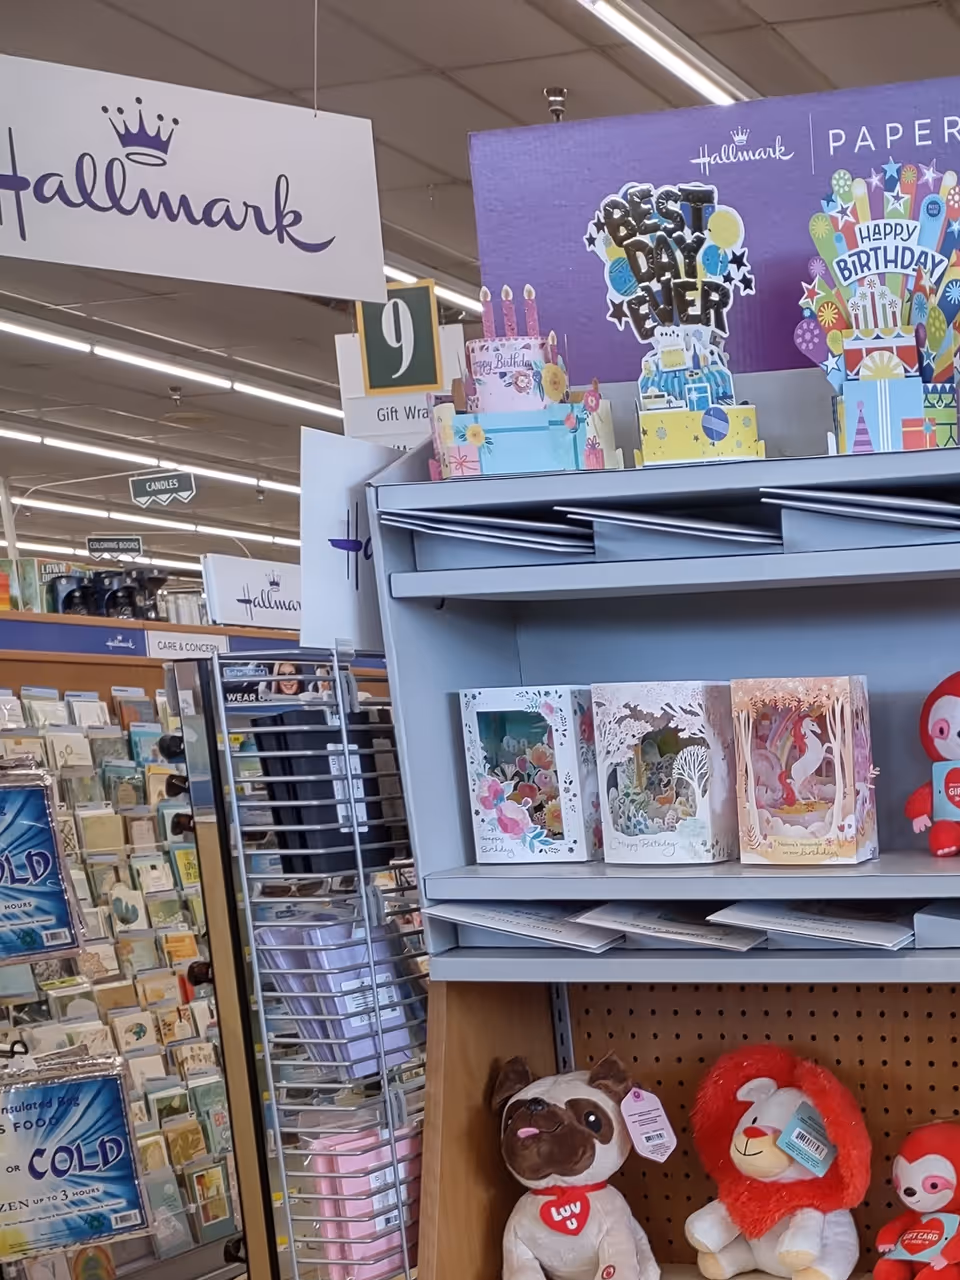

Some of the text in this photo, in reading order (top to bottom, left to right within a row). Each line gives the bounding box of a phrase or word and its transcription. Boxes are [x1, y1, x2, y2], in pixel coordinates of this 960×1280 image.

[690, 137, 795, 176] Hallmark
[0, 127, 336, 253] Hallmark
[603, 185, 715, 247] BEST
[858, 222, 918, 244] HAPPY
[623, 231, 706, 286] DAY
[627, 273, 731, 340] EVER
[381, 298, 415, 379] 9
[377, 406, 429, 422] Gift Wra
[145, 479, 179, 491] CANDLES
[158, 641, 219, 653] CARE & CONCERN
[226, 693, 258, 702] WEAR
[4, 901, 33, 911] HOURS
[13, 1117, 57, 1133] FOOD
[6, 1136, 124, 1181] OR COLD
[33, 1197, 44, 1205] UP
[47, 1195, 58, 1203] TO
[60, 1189, 69, 1202] 3
[72, 1187, 100, 1197] HOURS
[551, 1201, 580, 1221] LUV
[566, 1218, 578, 1230] U
[918, 1232, 939, 1241] CARD
